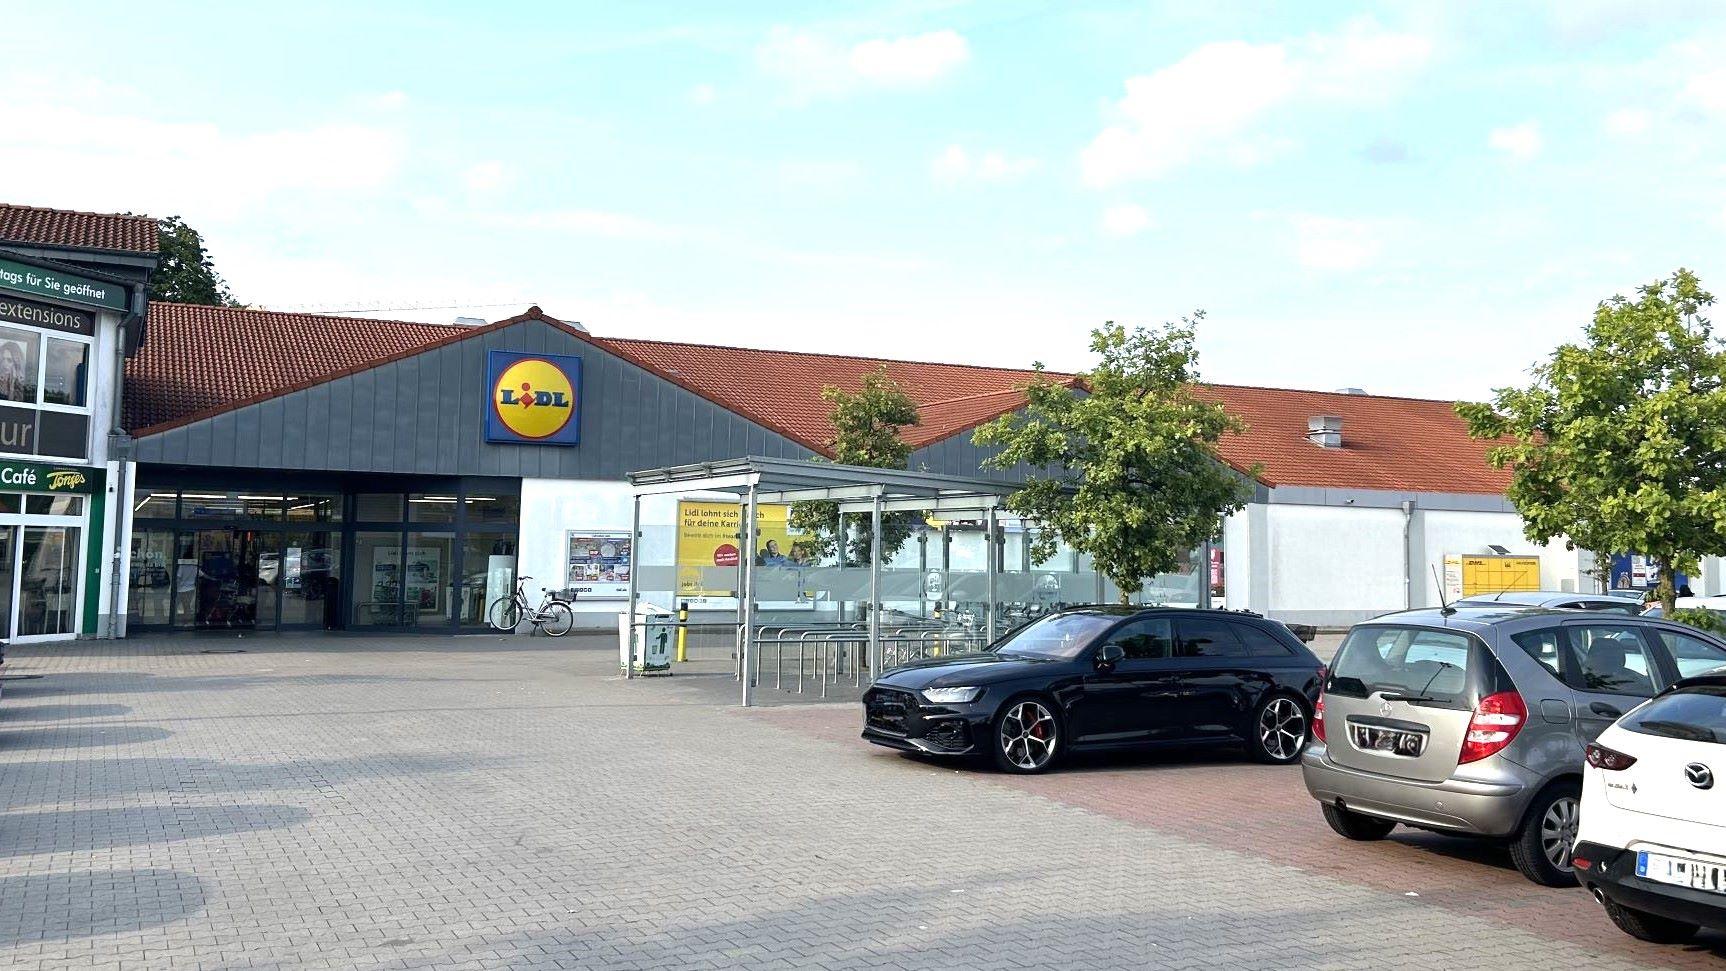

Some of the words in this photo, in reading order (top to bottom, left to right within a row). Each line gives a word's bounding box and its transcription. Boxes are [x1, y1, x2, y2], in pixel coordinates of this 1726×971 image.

[26, 272, 43, 287] für
[45, 277, 61, 291] Sie
[63, 283, 106, 300] geöffnet
[0, 302, 81, 329] extensions
[500, 382, 569, 409] LIDL
[1, 421, 32, 447] ur
[1, 468, 37, 485] Café
[684, 509, 699, 517] Lidl
[701, 510, 721, 518] lohnt
[723, 510, 739, 518] sich
[684, 519, 696, 527] für
[697, 520, 719, 528] deine
